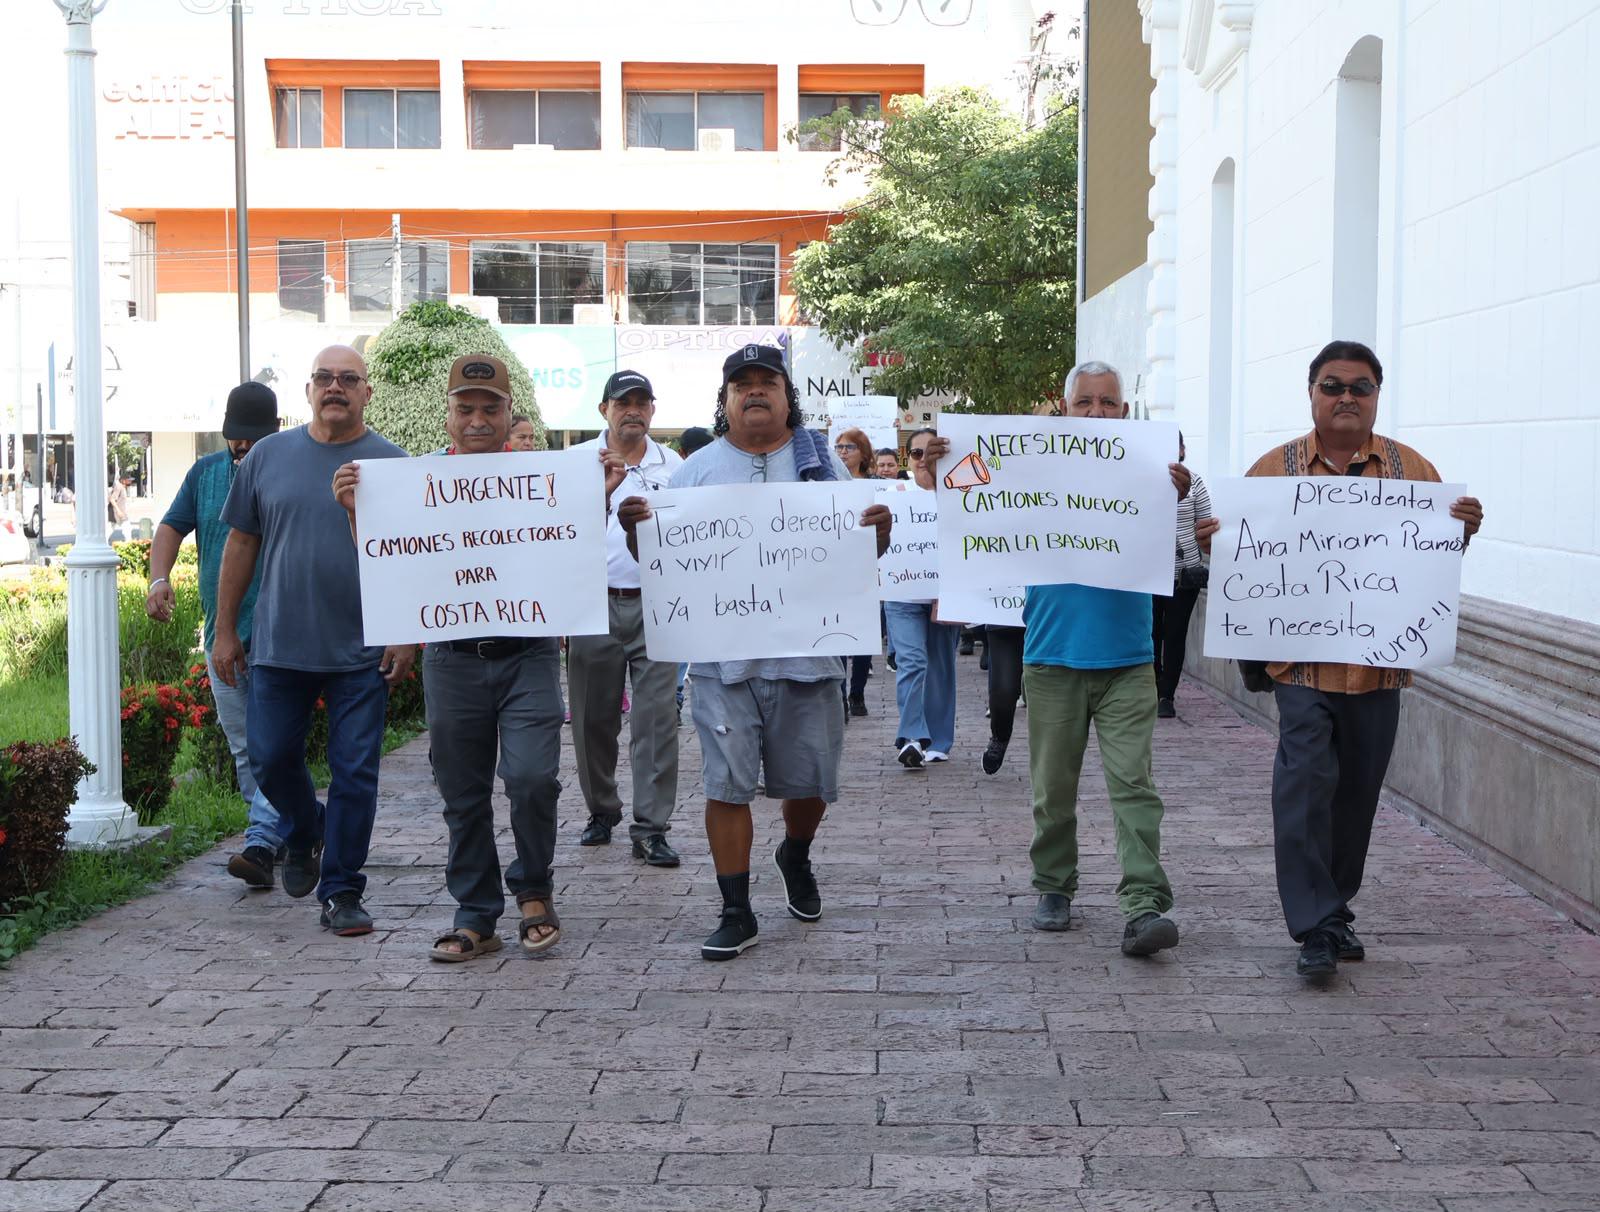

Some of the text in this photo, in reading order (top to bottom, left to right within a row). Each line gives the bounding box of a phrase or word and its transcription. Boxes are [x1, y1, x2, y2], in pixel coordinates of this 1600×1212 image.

[617, 329, 786, 351] OPTICA
[807, 376, 856, 397] NAIL
[976, 433, 1126, 461] NECESITAMOS
[424, 472, 557, 508] ¡URGENTE!
[962, 490, 1140, 516] CAMIONES NUEVOS
[648, 493, 855, 548] Tenemos derecho
[365, 524, 577, 558] CAMIONES RECOLECTORES
[906, 540, 938, 555] esper
[963, 532, 1121, 560] PARA LA BASURA
[1234, 517, 1465, 561] Ana Miriam Ramos
[649, 558, 663, 576] a
[758, 542, 828, 572] limpio
[455, 566, 498, 586] PARA
[1223, 559, 1400, 602] Costa Rica
[420, 599, 547, 630] COSTA RICA
[714, 583, 784, 619] basta!
[1220, 600, 1376, 639] te necesita
